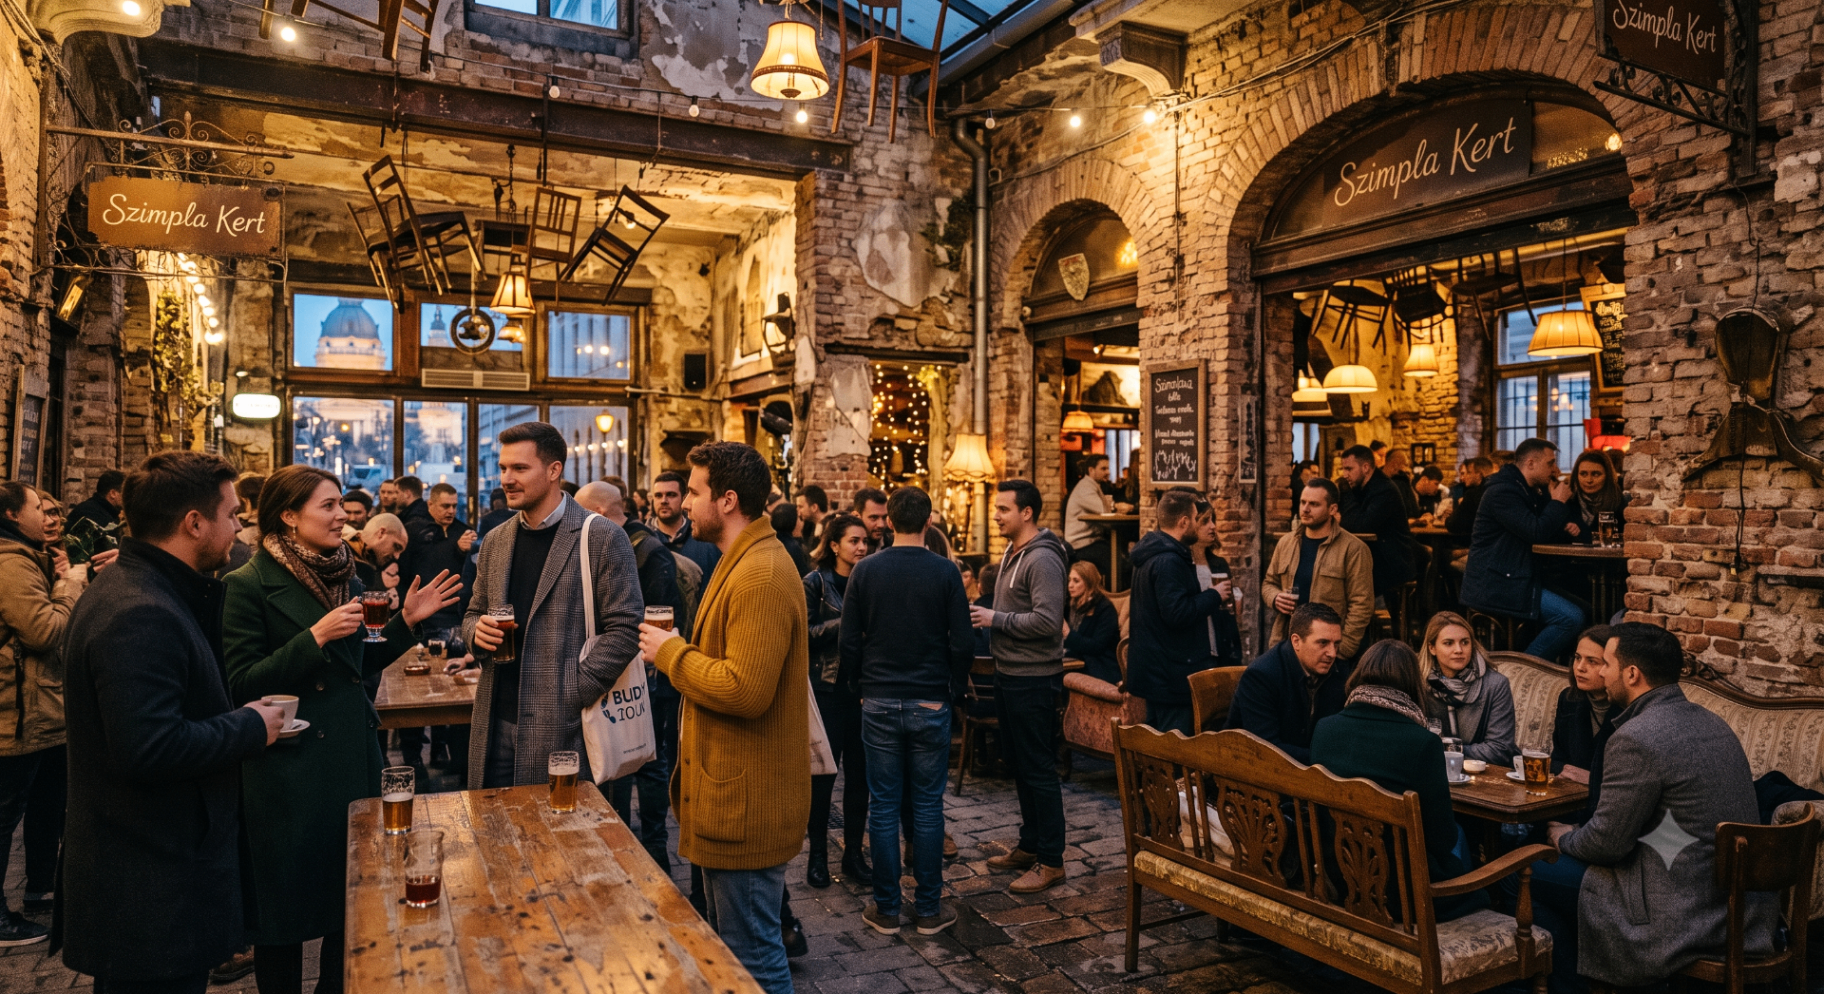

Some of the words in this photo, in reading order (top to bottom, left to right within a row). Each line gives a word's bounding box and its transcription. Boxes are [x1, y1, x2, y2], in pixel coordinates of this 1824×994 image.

[1612, 0, 1683, 49] Szimpla
[1685, 12, 1717, 55] Kert
[1334, 138, 1441, 207] Szimpla
[1450, 117, 1517, 176] Kert
[102, 193, 209, 235] Szimpla
[216, 204, 266, 237] Kert
